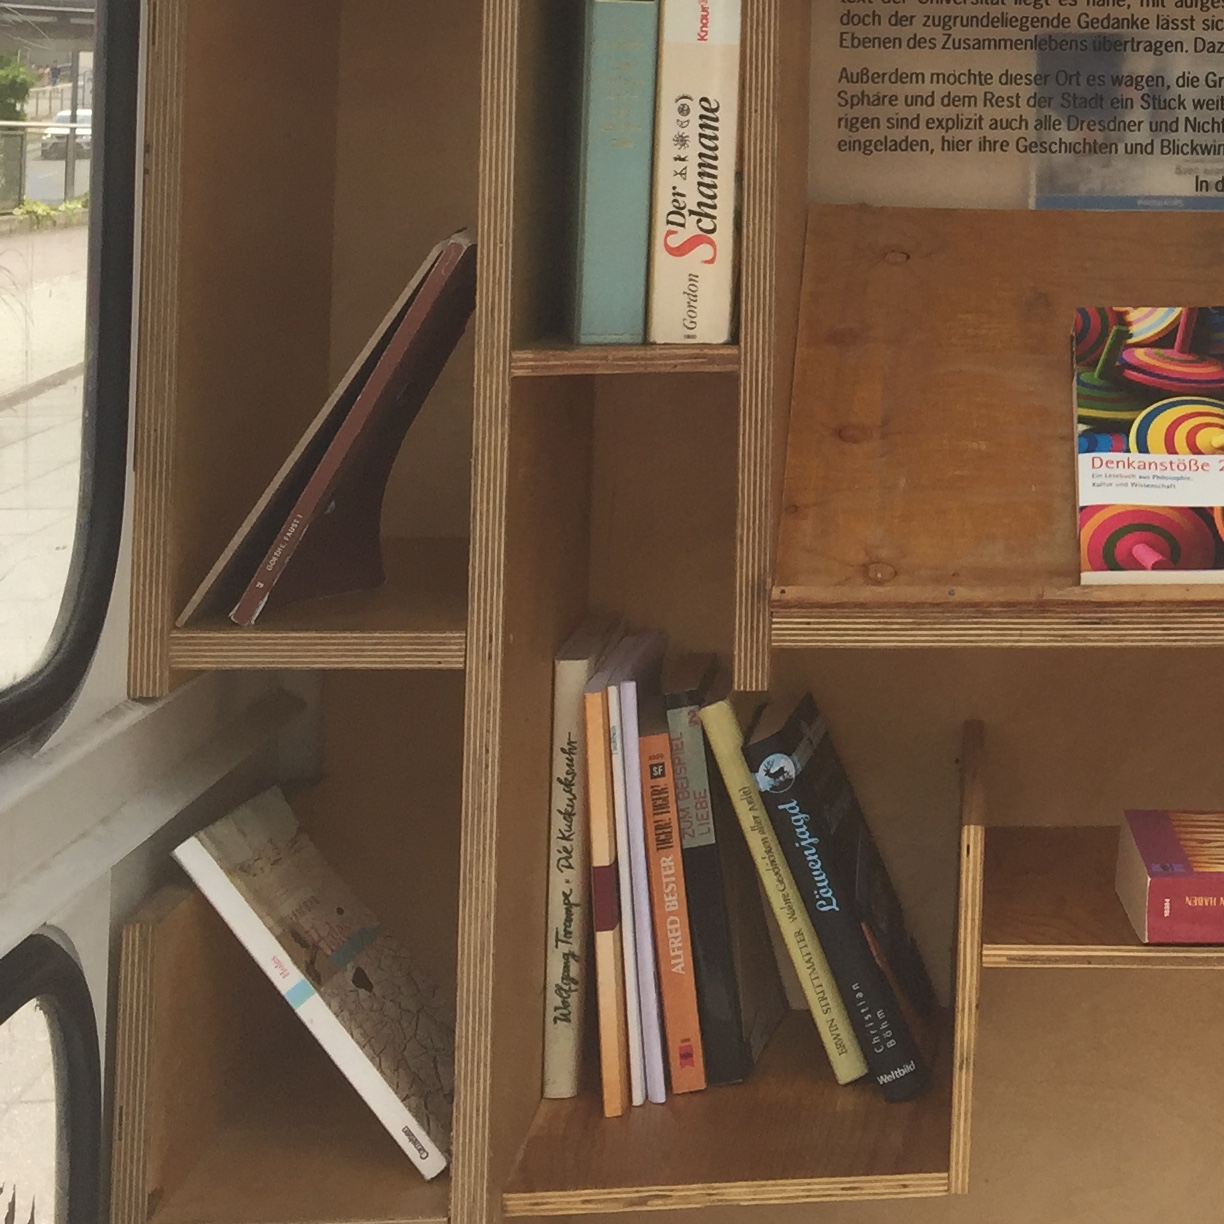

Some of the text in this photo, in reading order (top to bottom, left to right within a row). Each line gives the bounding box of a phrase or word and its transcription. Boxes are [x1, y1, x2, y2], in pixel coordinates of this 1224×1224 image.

[837, 67, 926, 87] Außerdem
[929, 68, 994, 88] möchte
[997, 69, 1051, 89] dieser
[1054, 69, 1082, 89] Ort
[1085, 74, 1106, 90] es
[1110, 74, 1172, 94] wagen,
[1174, 71, 1201, 91] die
[836, 135, 936, 159] eingeladen,
[939, 135, 974, 155] hier
[977, 136, 1011, 156] ihre
[1014, 136, 1119, 156] Geschichten
[1123, 137, 1155, 157] und
[664, 97, 721, 265] Schamane
[1194, 174, 1211, 194] In
[666, 186, 687, 230] Der
[682, 273, 700, 330] Gordon
[1091, 456, 1210, 472] Denkanstöße
[282, 517, 301, 541] FAUST
[670, 731, 695, 840] ZUM BEISPIEL
[649, 783, 674, 851] TIGER! TIGER!
[693, 788, 710, 835] LIEBE
[778, 795, 843, 918] Löwenjagd
[659, 854, 685, 975] ALFRED BESTER
[1185, 894, 1217, 907] HABEN
[553, 845, 580, 1024] Wolfgang Trampe Die
[792, 927, 848, 1057] ERWIN STRITTMATTER
[850, 982, 885, 1055] Christian
[874, 1009, 897, 1050] Böhm
[875, 1059, 916, 1086] Weltbild
